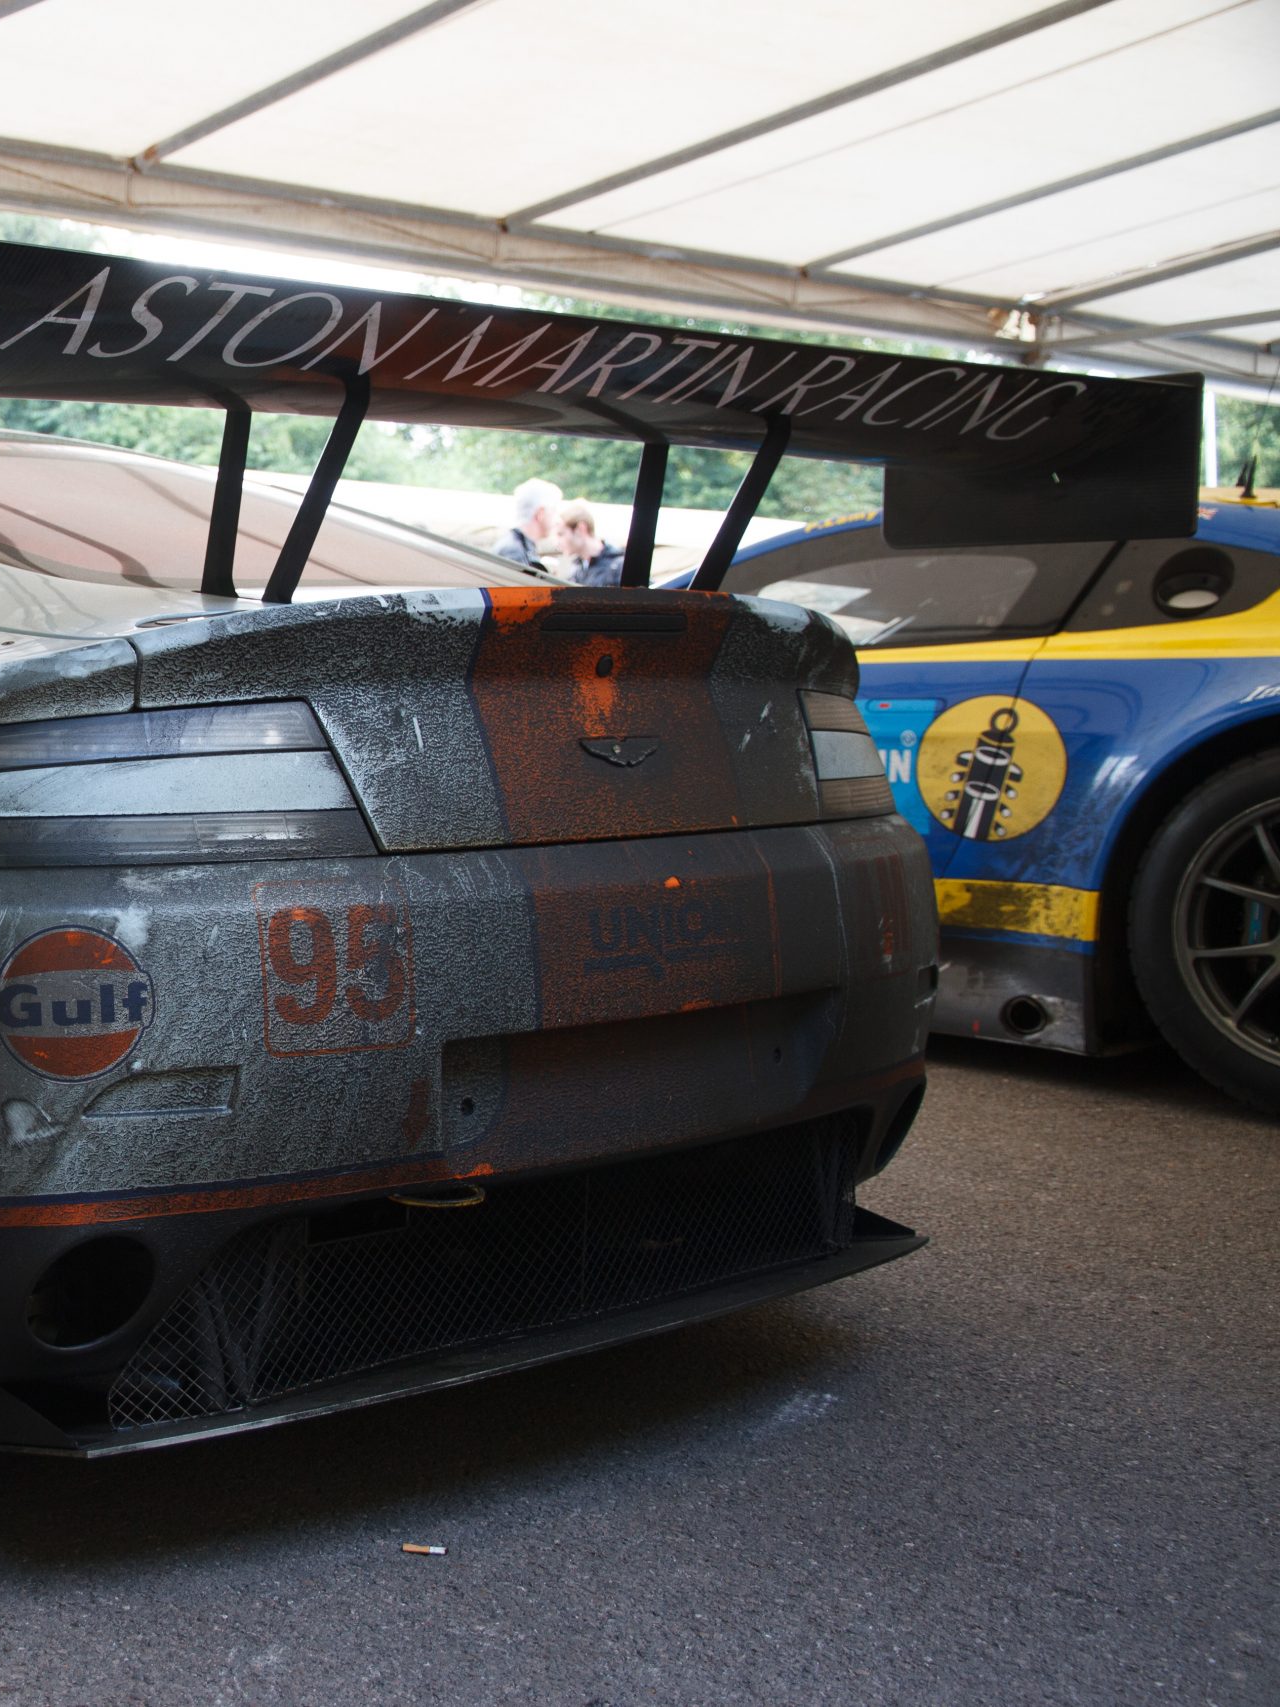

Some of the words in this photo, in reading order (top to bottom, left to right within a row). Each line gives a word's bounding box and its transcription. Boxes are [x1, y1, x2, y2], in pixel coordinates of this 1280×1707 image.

[403, 314, 799, 414] MARTIN
[766, 354, 1087, 441] RACING
[267, 902, 406, 1025] 95
